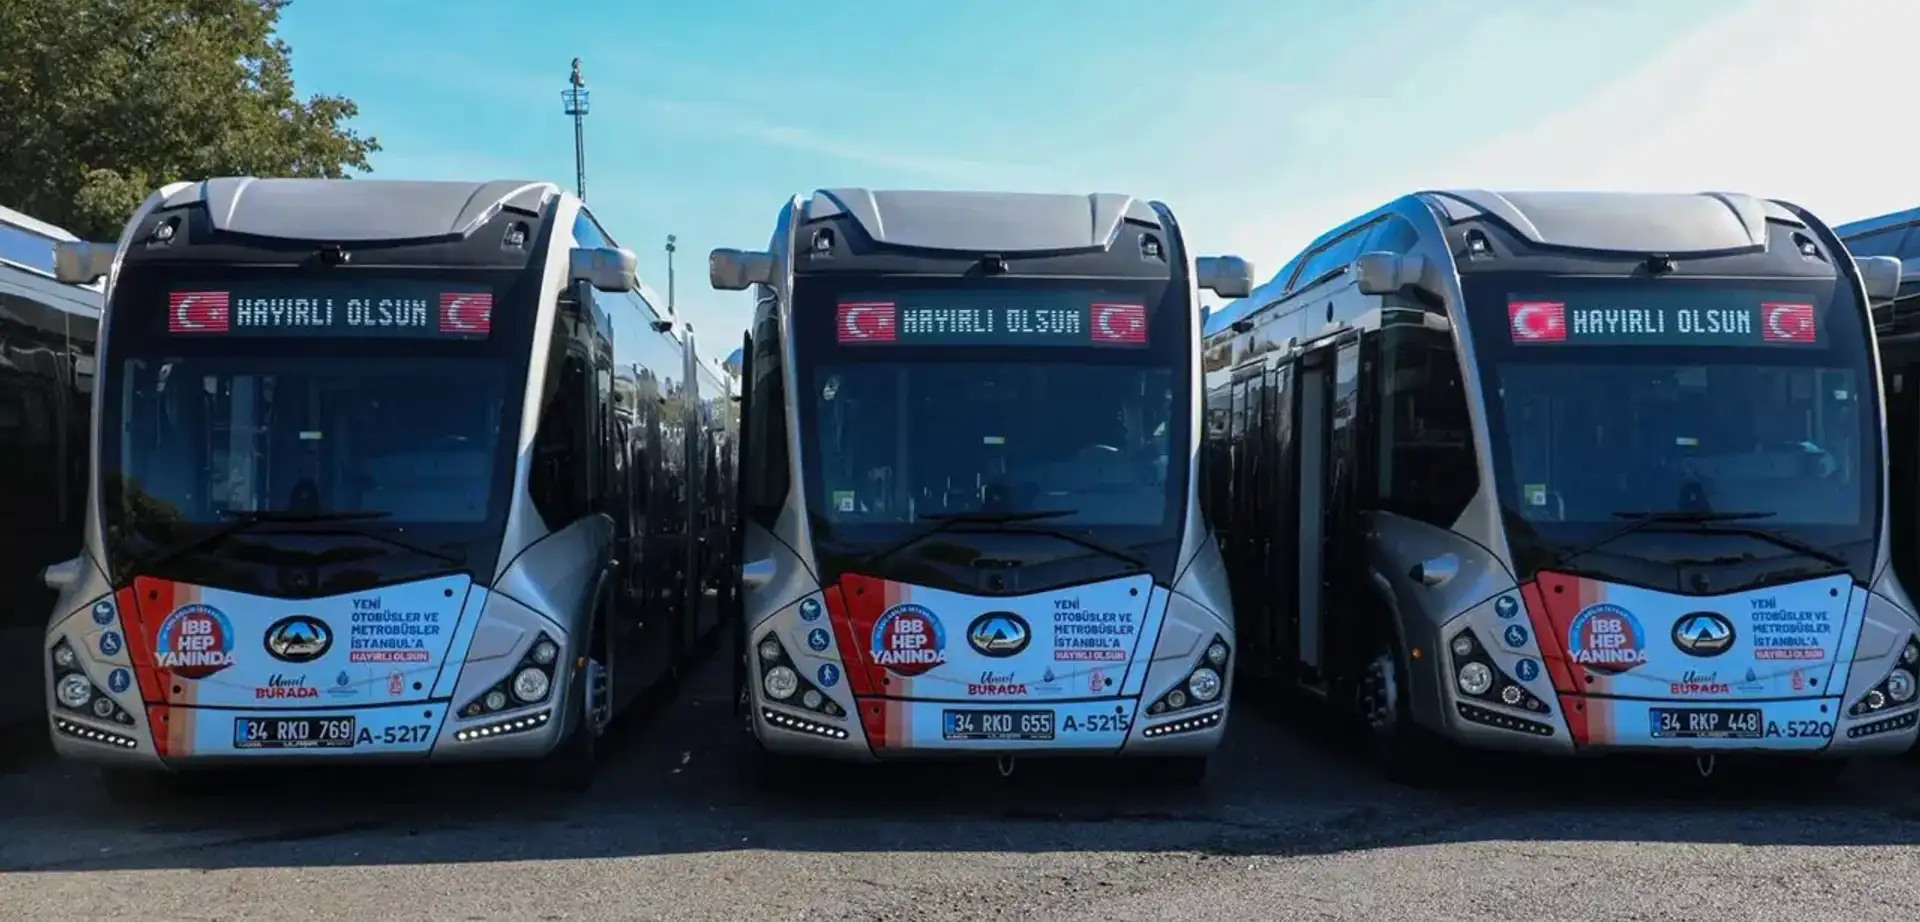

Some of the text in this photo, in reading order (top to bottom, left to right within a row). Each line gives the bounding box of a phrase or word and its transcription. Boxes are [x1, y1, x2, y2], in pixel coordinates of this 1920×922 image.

[236, 298, 426, 326] HAYIRLI OLSUN
[904, 309, 1080, 333] HAYIRLI OLSUN
[1573, 309, 1751, 334] HAYIRLI OLSUN
[352, 596, 381, 609] YENİ
[1054, 596, 1080, 609] YENİ
[352, 610, 440, 622] OTOBÜSLER VE
[1054, 610, 1132, 622] OTOBÜSLER VE
[182, 616, 213, 635] İBB
[351, 622, 440, 635] METROBÜSLER
[894, 616, 924, 634] İBB
[1054, 622, 1134, 635] METROBÜSLER
[1591, 616, 1622, 633] İBB
[178, 635, 216, 650] HEP
[892, 634, 928, 649] HEP
[1590, 634, 1627, 648] HEP
[154, 652, 236, 666] YANINDA
[869, 649, 947, 664] YANINDA
[1566, 648, 1649, 664] YANINDA
[255, 688, 319, 699] BURADA
[968, 684, 1028, 696] BURADA
[1670, 683, 1730, 694] BURADA
[955, 714, 1050, 732] 34 RKD 655
[1062, 714, 1130, 732] A-5215
[1661, 713, 1757, 730] 34 RKP 448
[1766, 720, 1833, 738] A-5220
[247, 720, 350, 740] 34 RKD 769
[356, 725, 432, 744] A-5217
